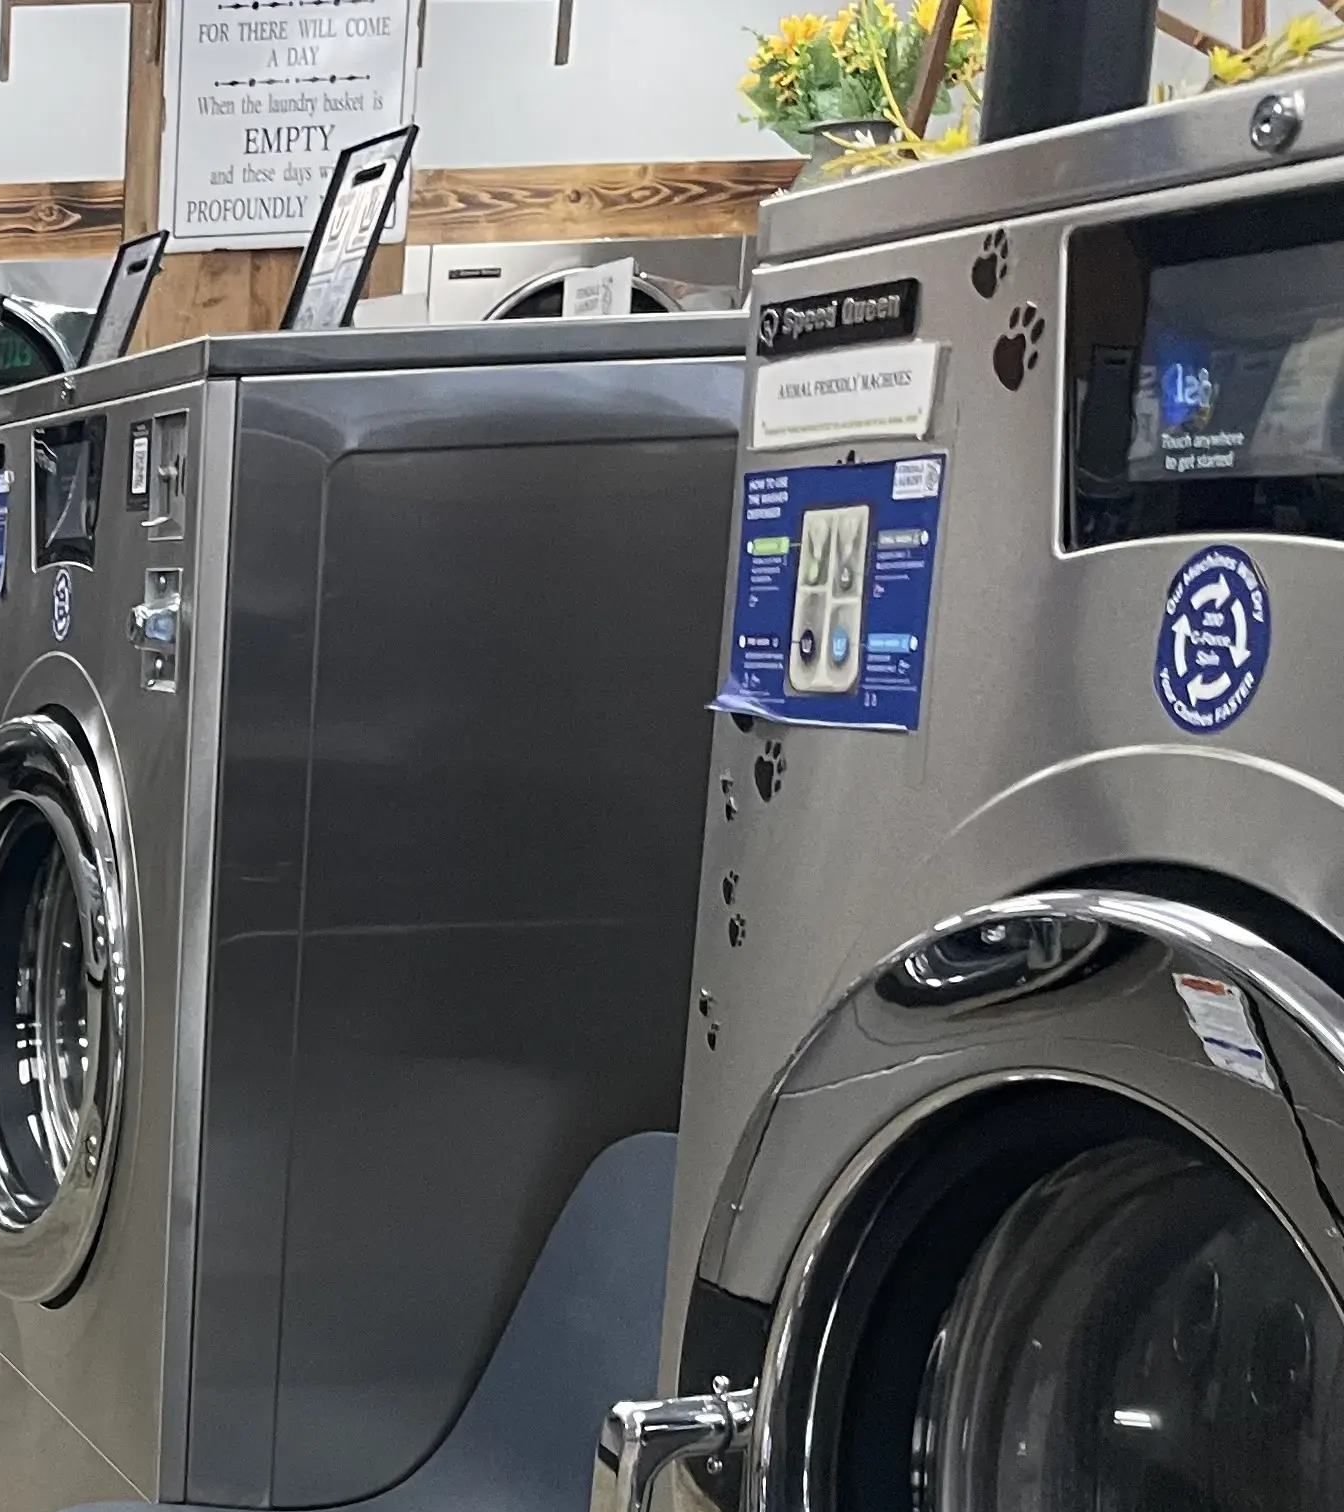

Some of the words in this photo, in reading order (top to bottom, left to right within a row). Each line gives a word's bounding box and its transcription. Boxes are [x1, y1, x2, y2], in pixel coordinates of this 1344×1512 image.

[198, 23, 229, 43] FOR
[238, 21, 288, 42] THERE
[298, 18, 337, 40] WILL
[345, 17, 391, 38] COME
[267, 48, 279, 68] A
[287, 46, 320, 67] DAY
[197, 96, 235, 116] When
[241, 94, 262, 115] the
[268, 92, 318, 117] laundry
[323, 91, 364, 112] basket
[372, 90, 384, 111] is
[243, 125, 336, 155] EMPTY
[210, 165, 234, 186] and
[242, 163, 275, 184] these
[282, 162, 312, 187] days
[186, 196, 308, 224] PROFOUNDLY
[782, 300, 838, 340] Speed
[841, 294, 901, 325] Queen
[1214, 670, 1256, 724] FASTER
